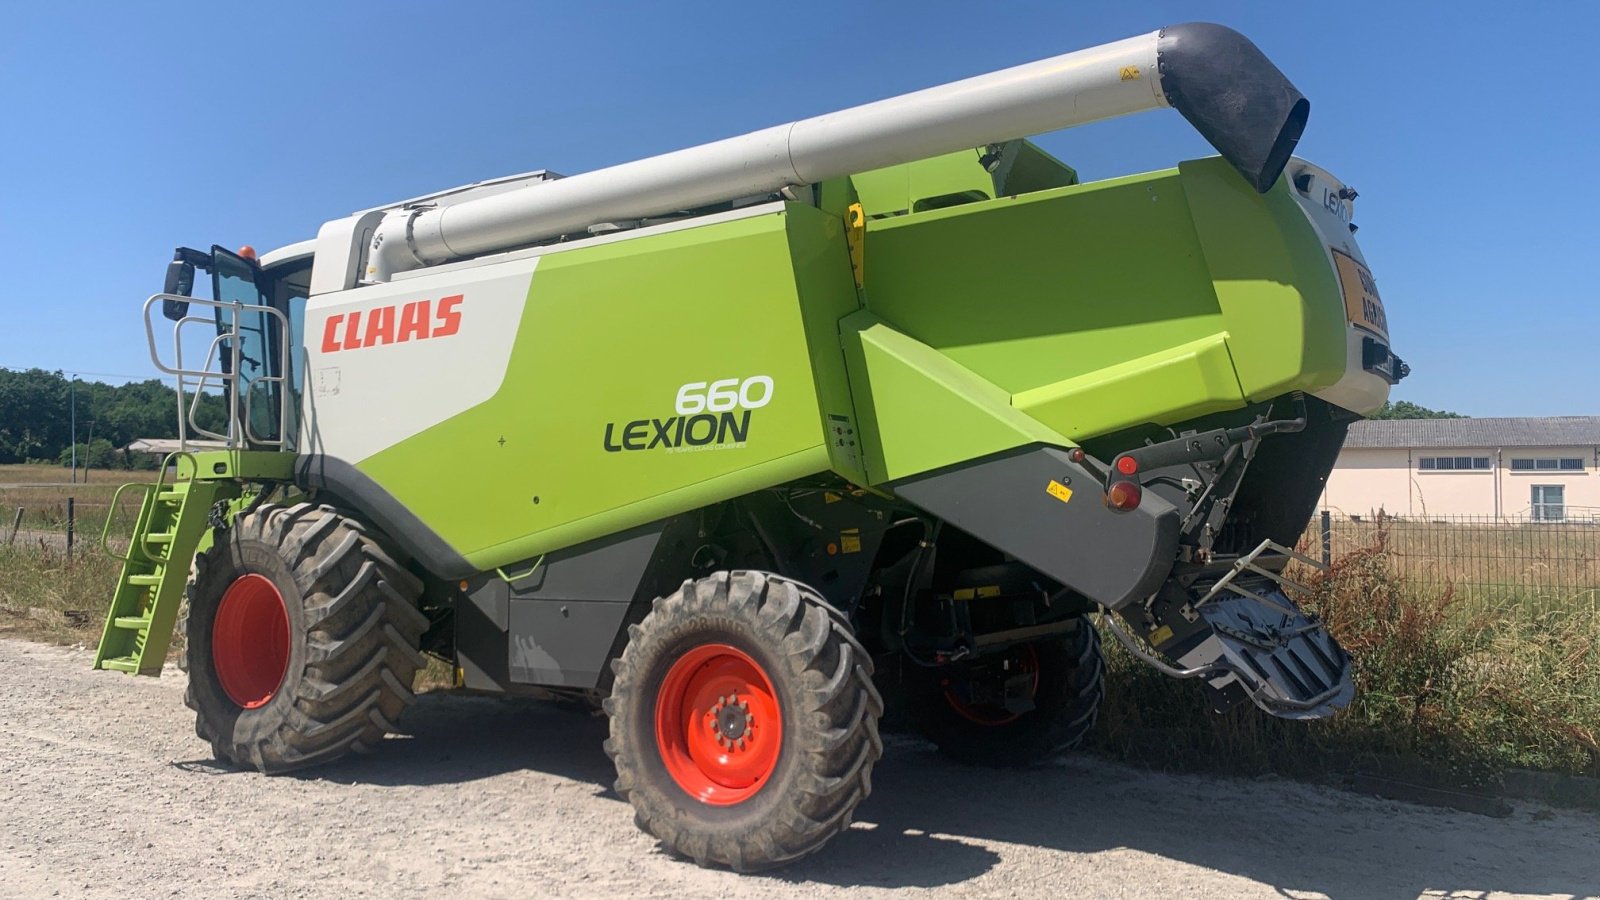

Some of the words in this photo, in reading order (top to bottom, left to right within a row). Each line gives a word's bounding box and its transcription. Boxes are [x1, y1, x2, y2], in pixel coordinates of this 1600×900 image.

[321, 294, 464, 353] CLAAS
[675, 375, 774, 415] 660
[603, 410, 751, 452] LEXION
